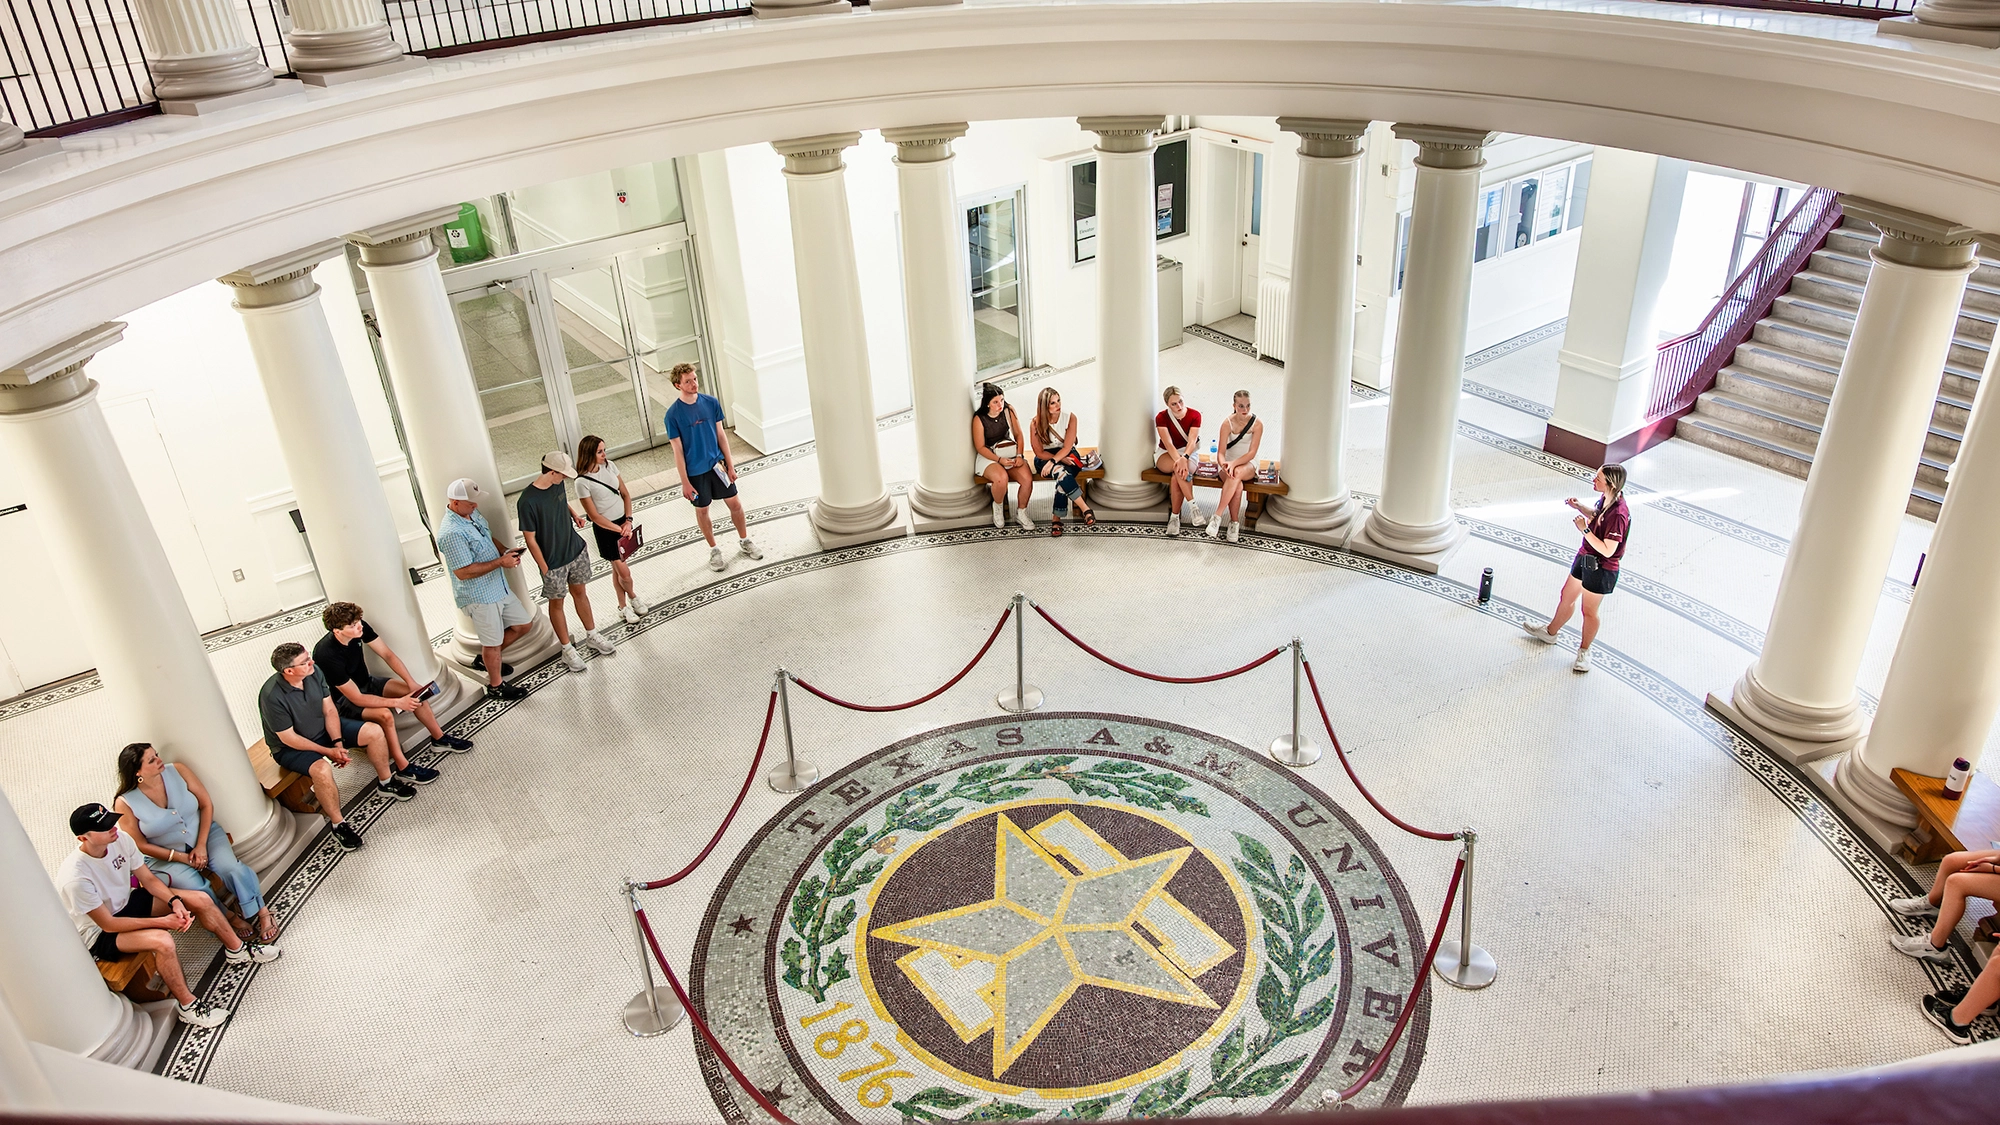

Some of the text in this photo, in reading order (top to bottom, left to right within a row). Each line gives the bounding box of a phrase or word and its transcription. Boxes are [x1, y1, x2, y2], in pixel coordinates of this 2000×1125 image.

[786, 727, 1024, 835] TEXAS
[722, 1097, 741, 1119] THE
[800, 1001, 916, 1108] 1876
